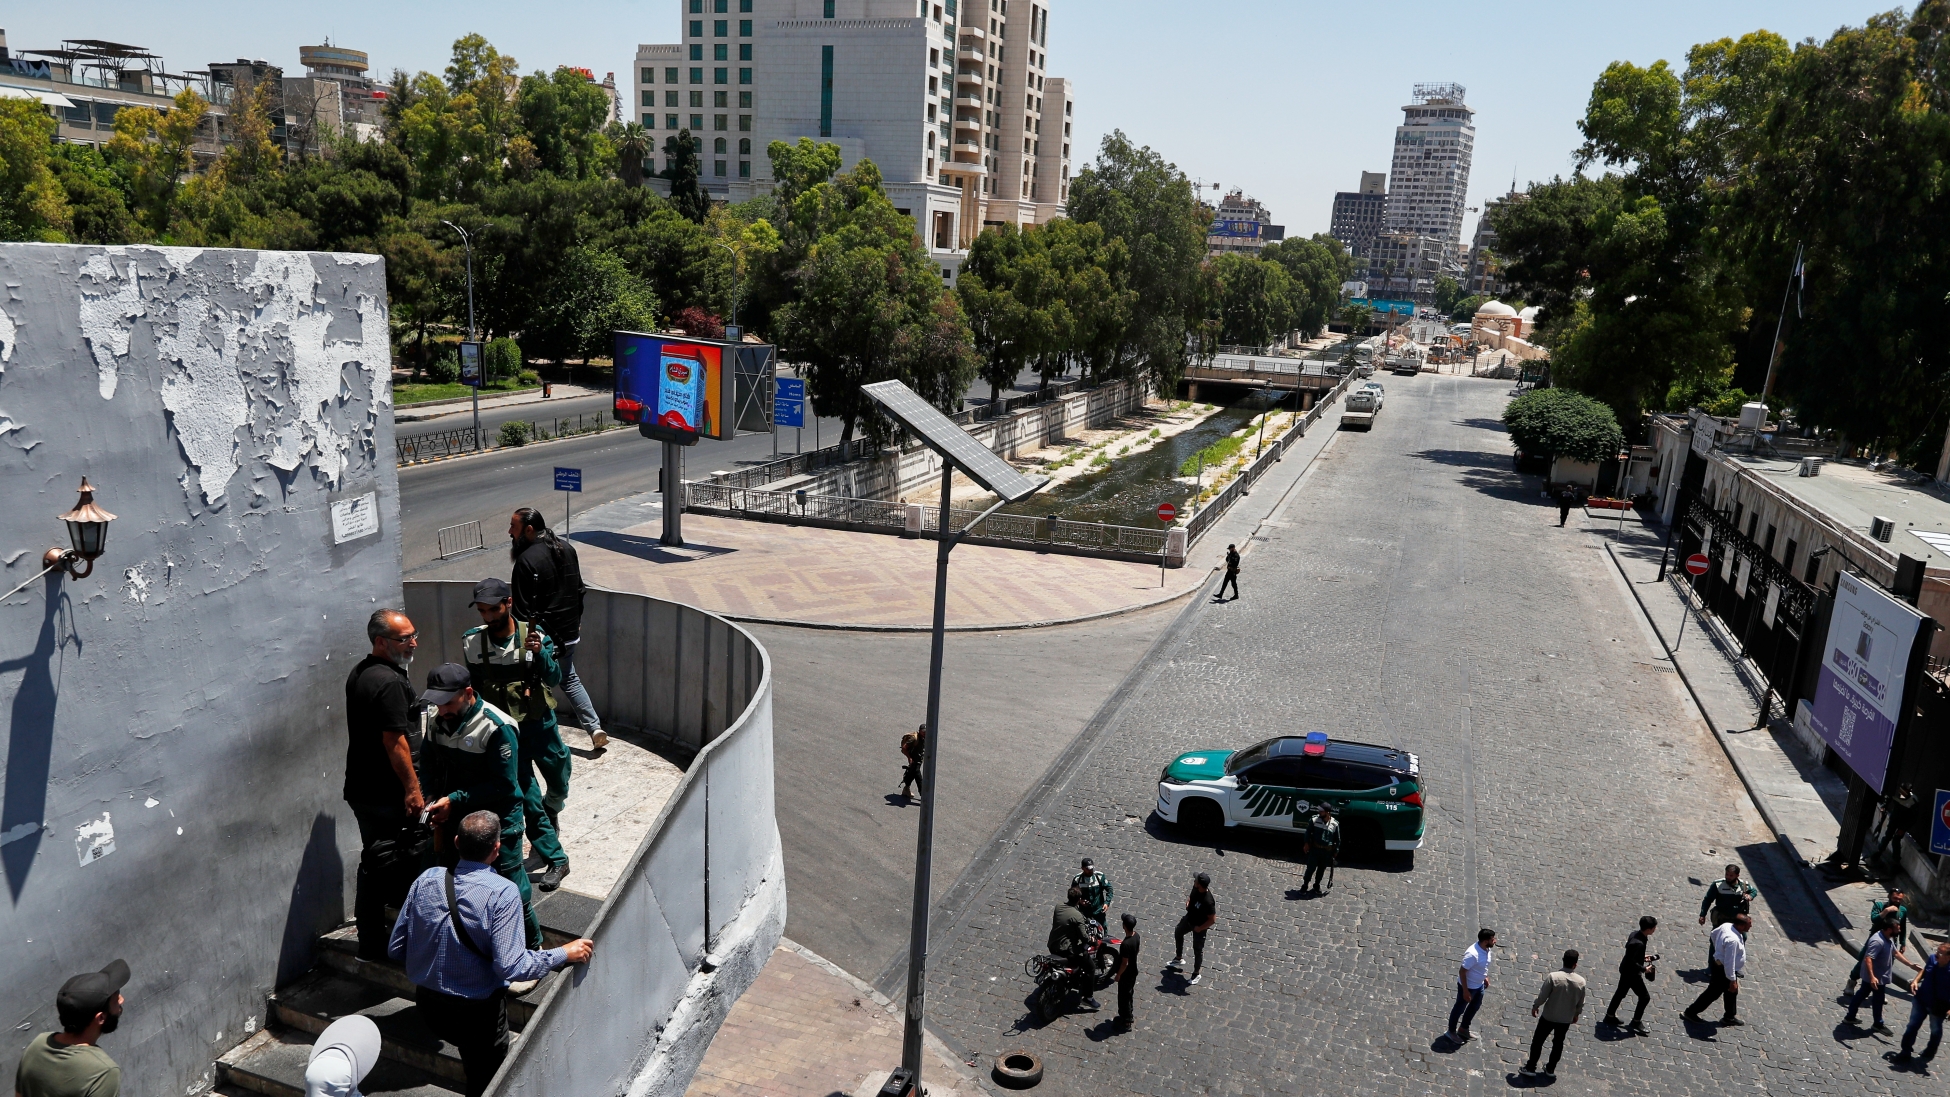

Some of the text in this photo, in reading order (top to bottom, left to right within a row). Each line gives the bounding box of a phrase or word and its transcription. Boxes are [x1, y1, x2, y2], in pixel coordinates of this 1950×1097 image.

[1840, 578, 1858, 596] SAMSUNG
[1862, 620, 1874, 635] Galaxy
[1861, 703, 1876, 722] الفرصة
